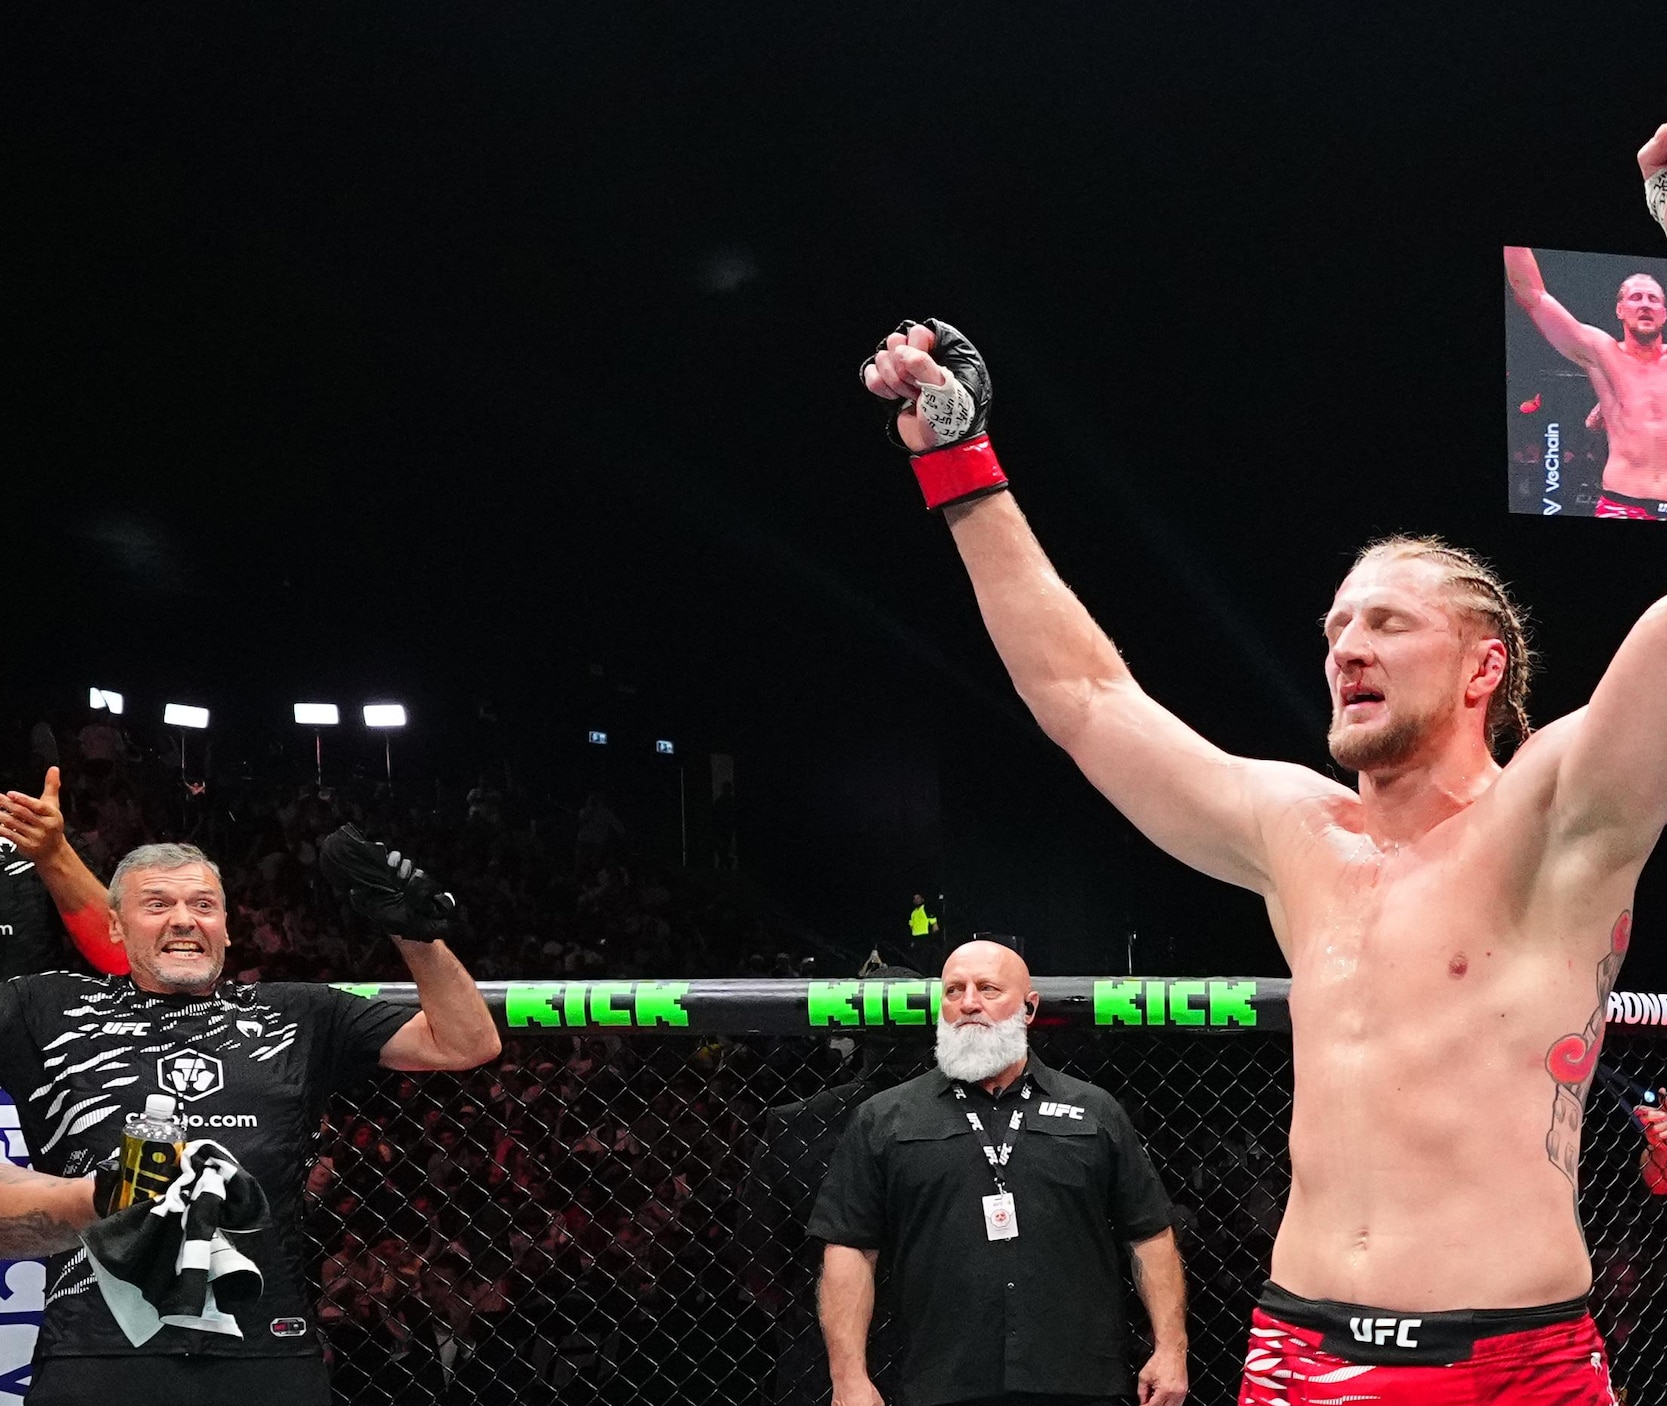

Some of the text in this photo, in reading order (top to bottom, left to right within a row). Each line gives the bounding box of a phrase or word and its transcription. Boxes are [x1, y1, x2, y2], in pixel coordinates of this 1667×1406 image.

[1544, 422, 1560, 492] VeChain
[506, 981, 690, 1028] KICK
[808, 981, 942, 1026] KIC
[1093, 980, 1258, 1026] KICK
[101, 1021, 152, 1037] UFC
[966, 1112, 984, 1131] UFC
[1009, 1110, 1024, 1131] UFC
[1038, 1102, 1085, 1121] UFC
[983, 1146, 999, 1165] UFC
[999, 1142, 1013, 1166] UFC
[1349, 1317, 1422, 1348] UFC
